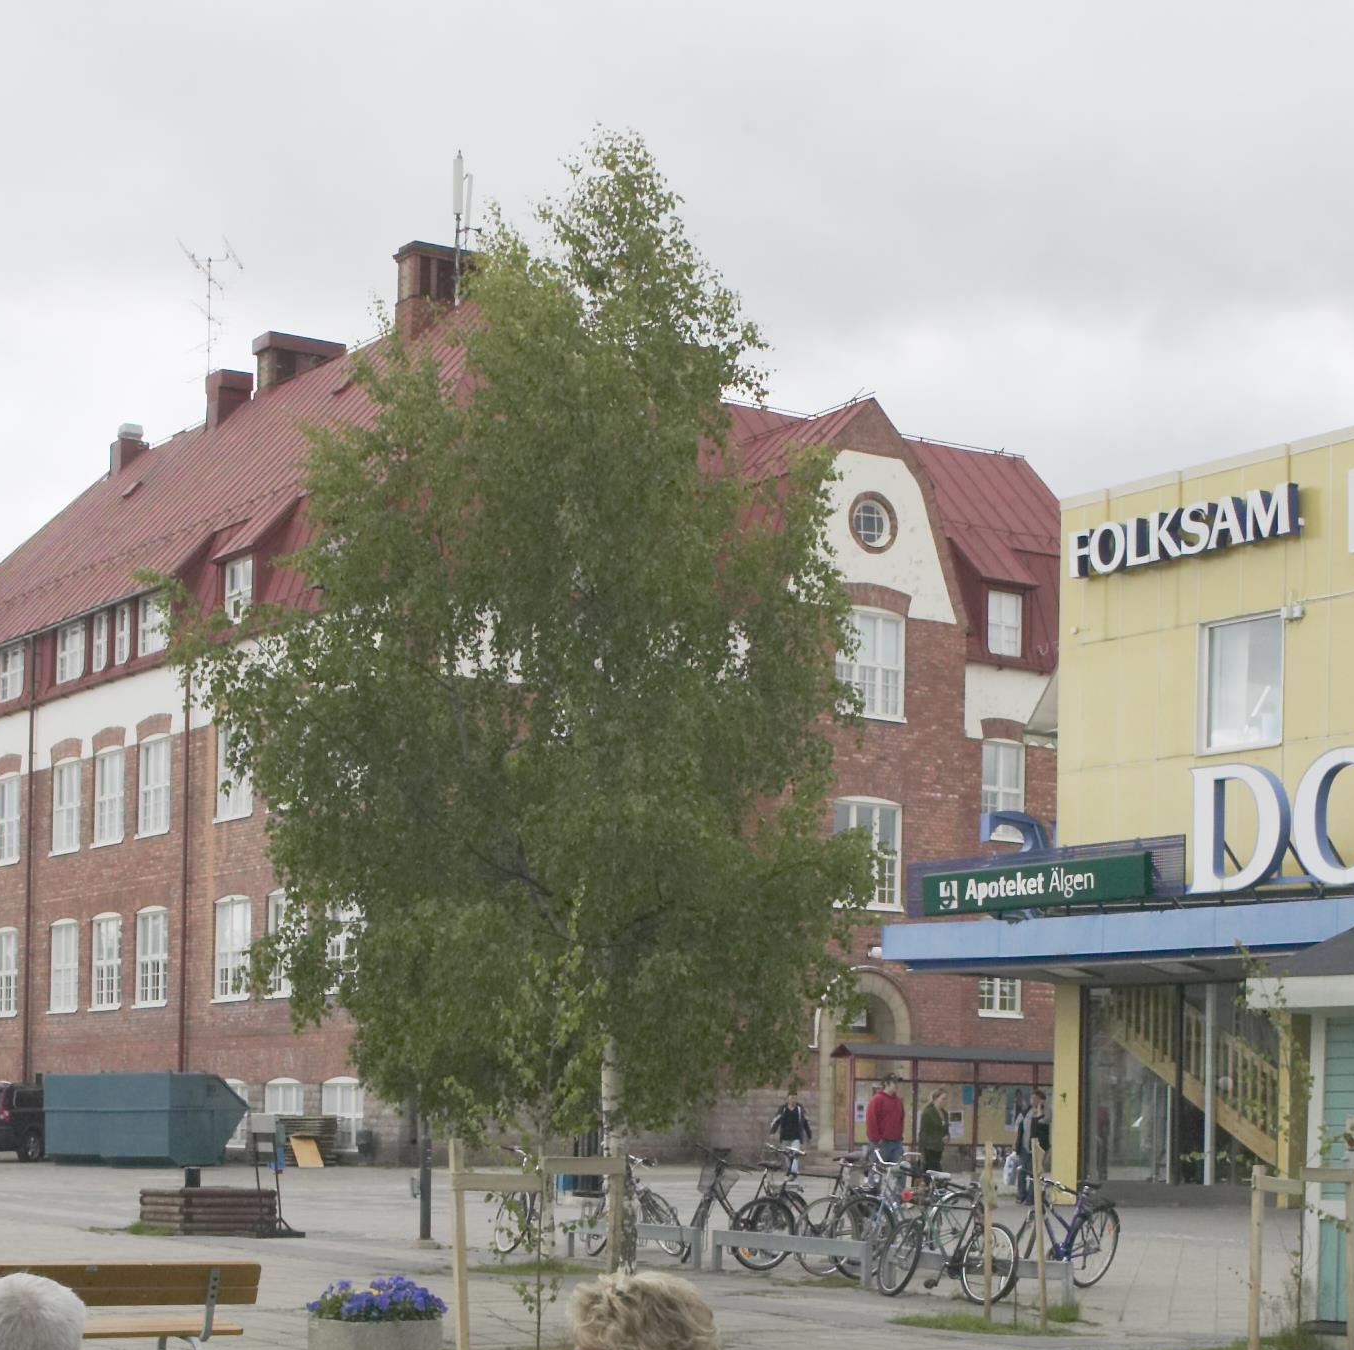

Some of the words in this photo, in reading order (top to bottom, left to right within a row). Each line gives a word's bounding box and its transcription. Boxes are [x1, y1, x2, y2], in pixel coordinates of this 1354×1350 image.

[1068, 482, 1299, 579] FOLKSAM
[964, 871, 1045, 907] Apoteket
[1048, 867, 1095, 899] Älgen
